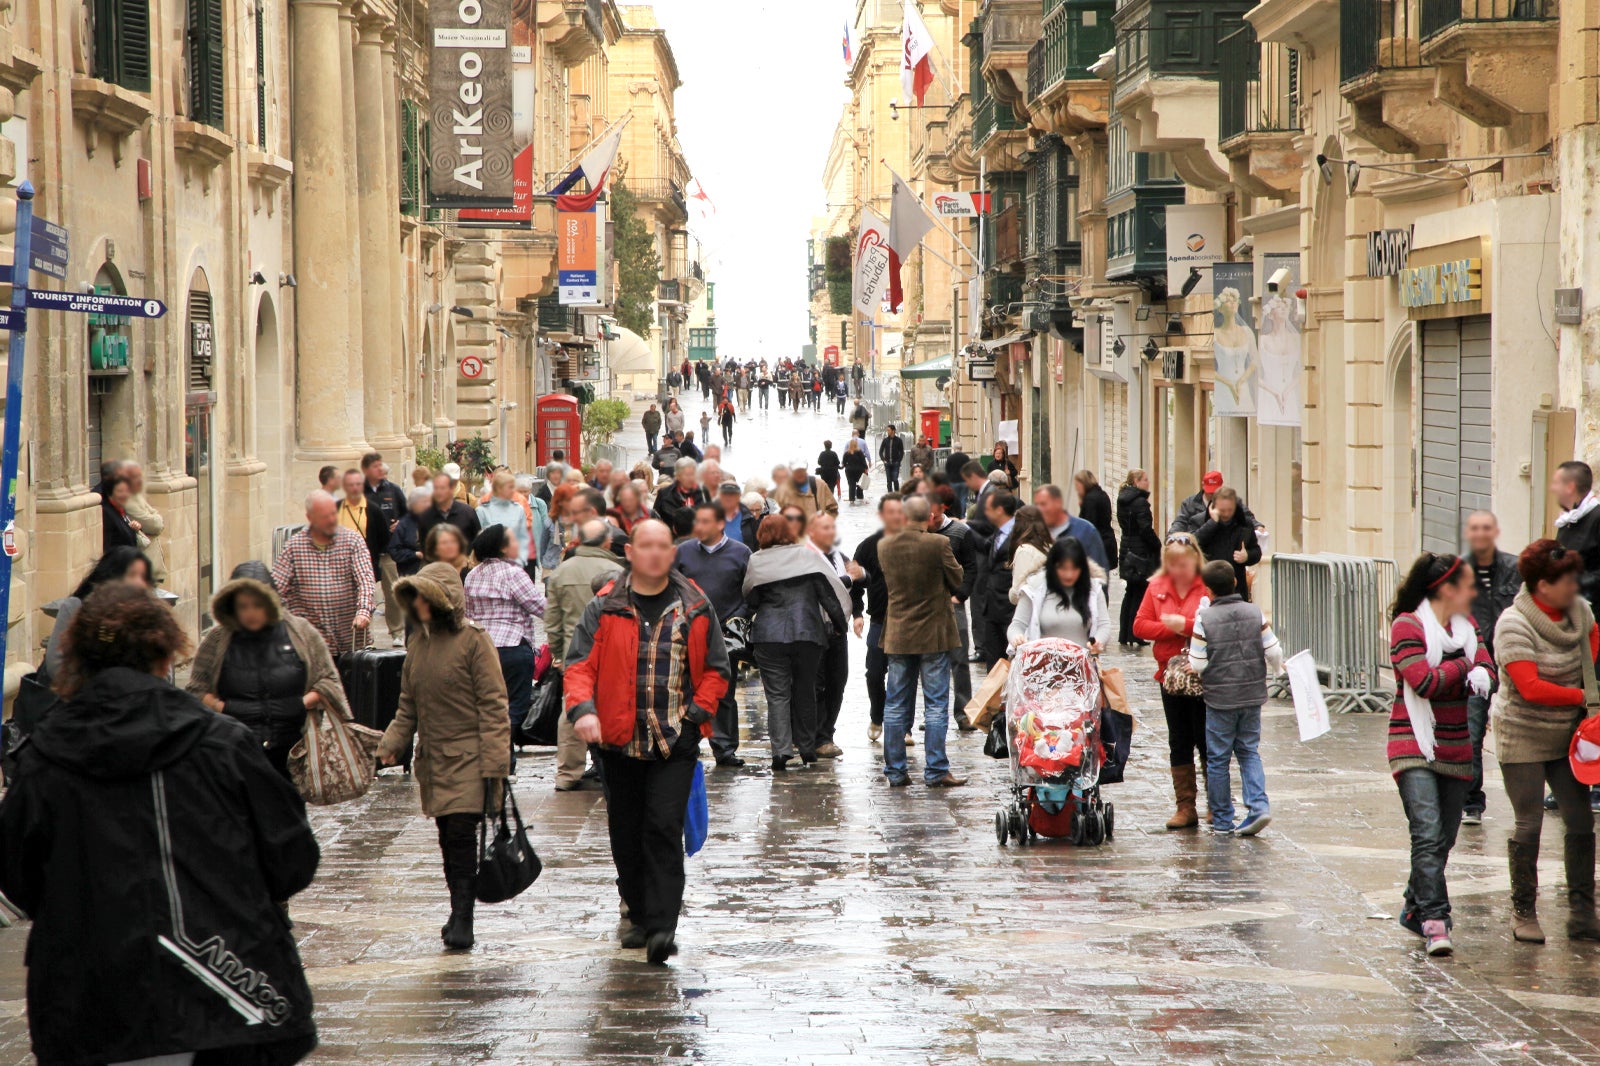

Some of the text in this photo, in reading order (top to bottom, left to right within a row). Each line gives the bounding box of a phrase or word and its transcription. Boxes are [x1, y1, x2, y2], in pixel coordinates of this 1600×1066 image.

[32, 291, 142, 307] TOURIST INFORMATION
[70, 302, 104, 312] OFFICE
